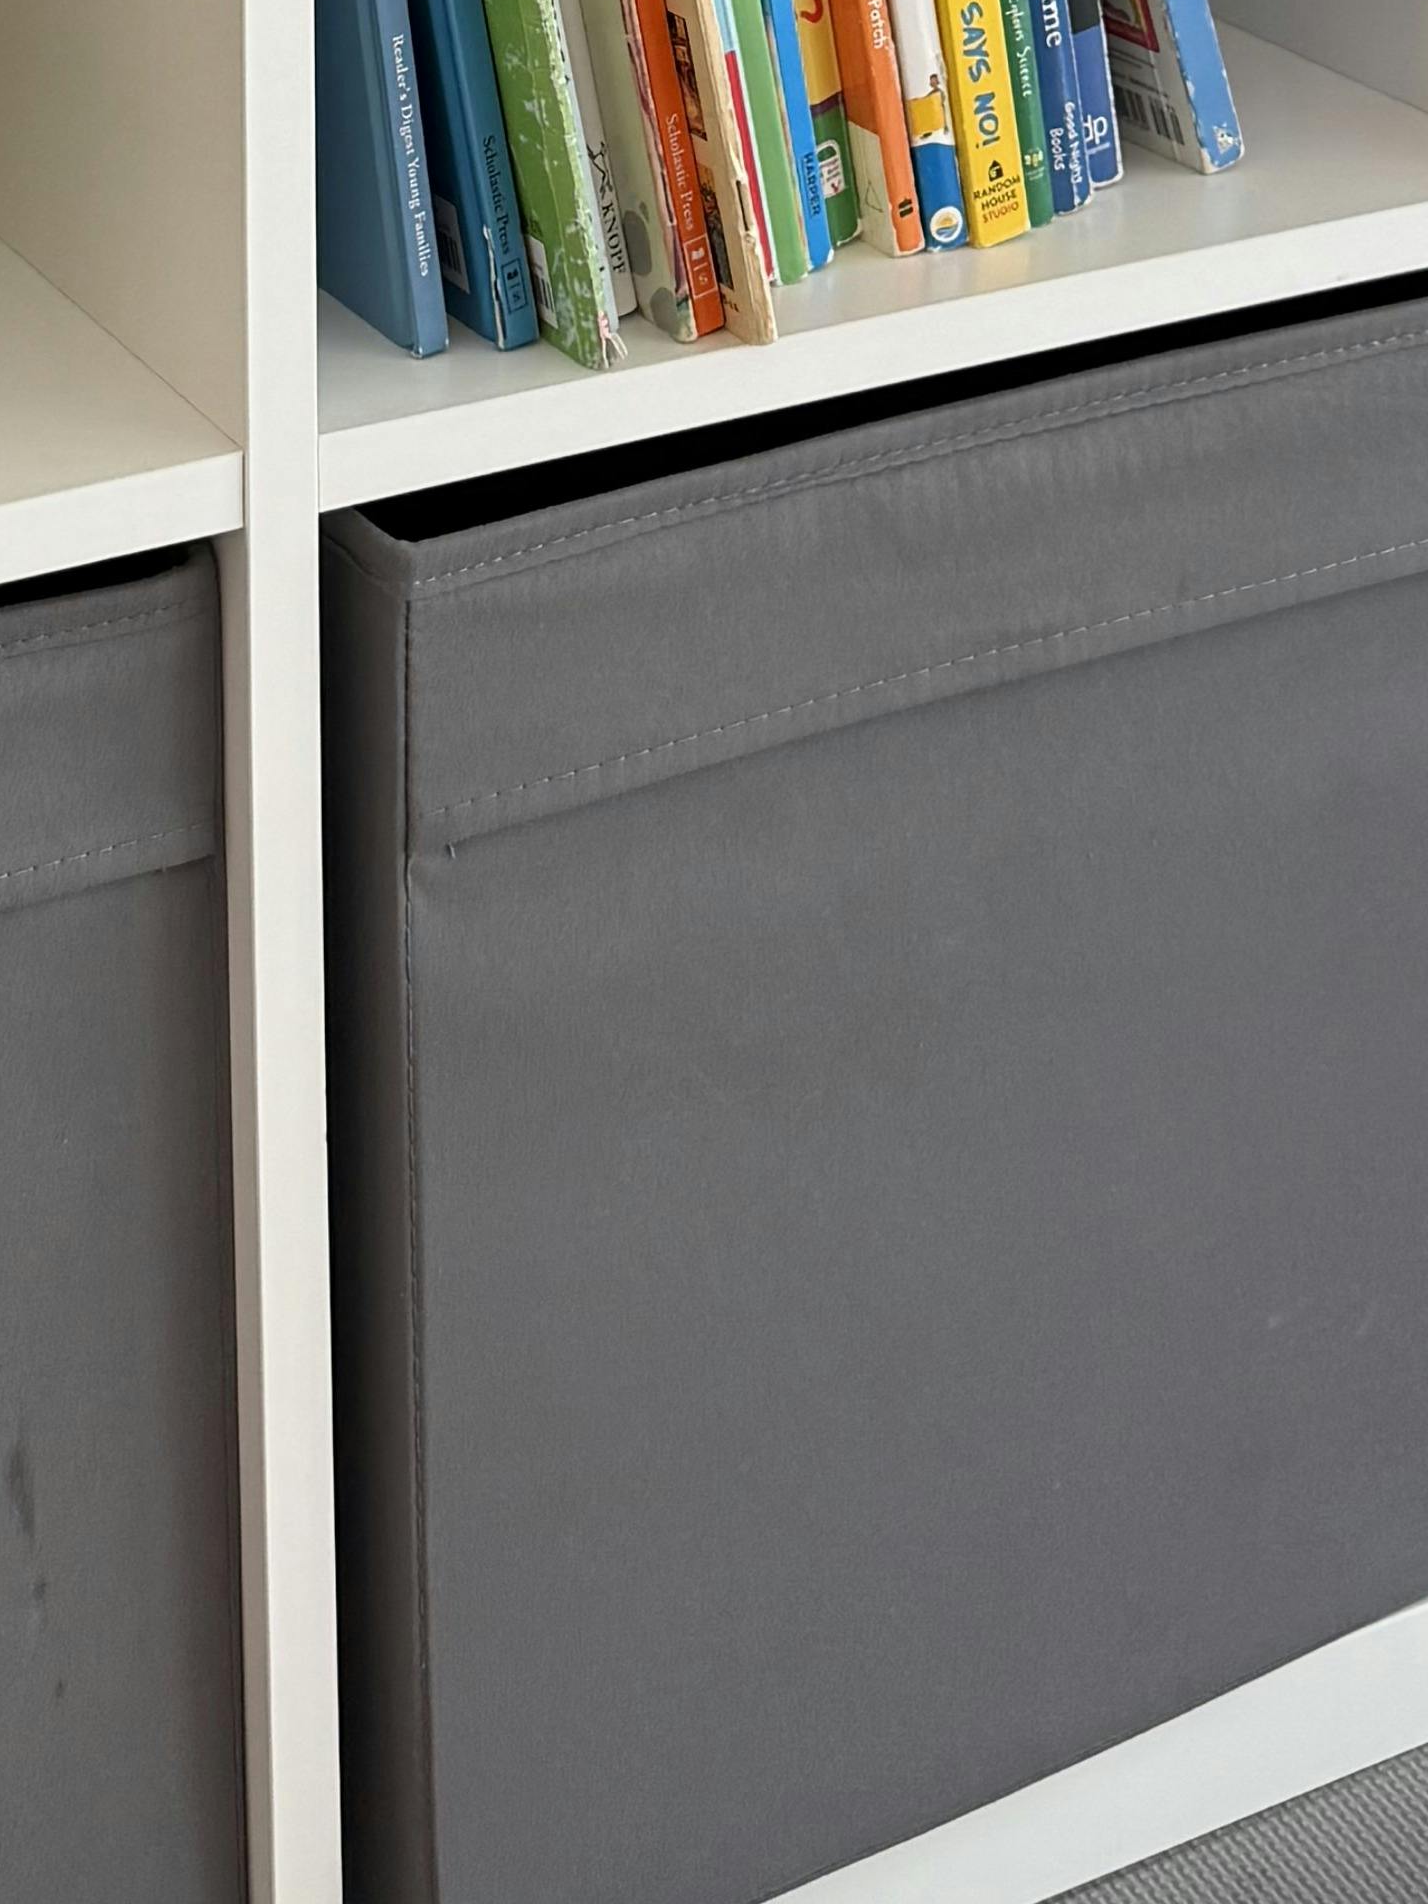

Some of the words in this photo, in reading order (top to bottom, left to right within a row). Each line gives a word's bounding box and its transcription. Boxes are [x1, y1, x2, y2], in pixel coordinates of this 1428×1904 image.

[392, 33, 408, 102] Reader's
[960, 0, 992, 84] SAYS
[1016, 44, 1033, 98] Science
[400, 102, 414, 154] Digest
[974, 91, 1002, 150] NO!
[1064, 100, 1077, 140] Good
[666, 112, 688, 190] Scholastic
[679, 190, 695, 232] Press
[1049, 127, 1065, 172] Books
[1069, 140, 1083, 185] Night
[404, 155, 421, 210] Young
[483, 136, 505, 208] Scholastic
[495, 208, 512, 256] Press
[803, 152, 822, 218] HARPER
[973, 175, 1021, 201] RANDOM
[981, 189, 1018, 211] HOUSE
[601, 201, 626, 274] KNOPF
[982, 200, 1020, 224] STUDIO
[414, 210, 430, 278] Families
